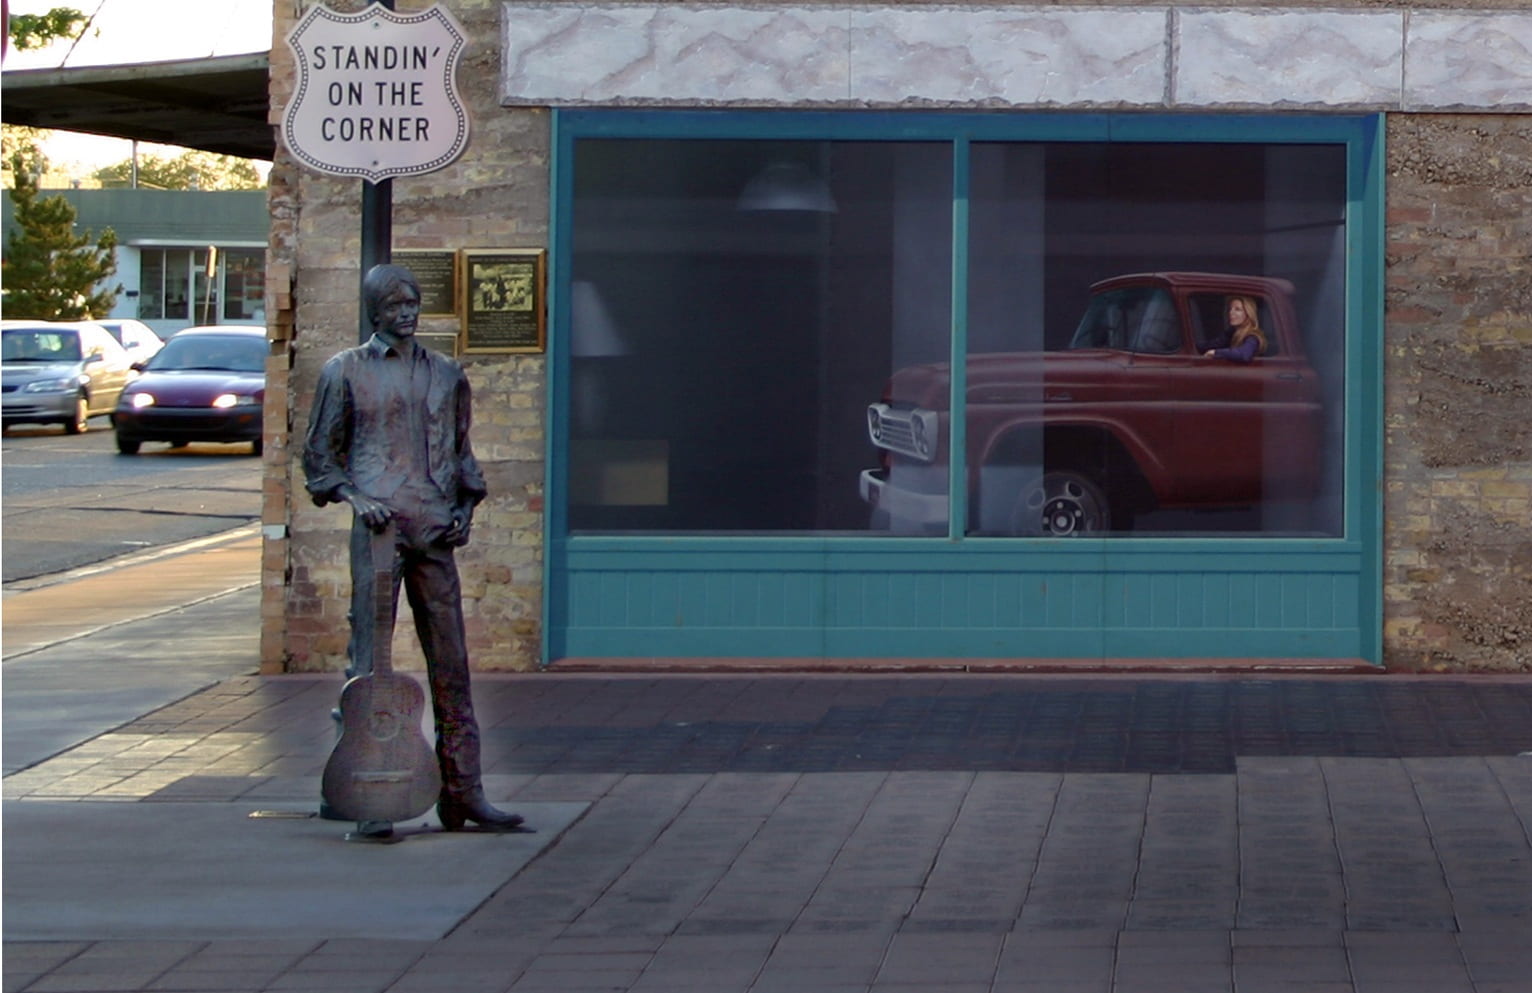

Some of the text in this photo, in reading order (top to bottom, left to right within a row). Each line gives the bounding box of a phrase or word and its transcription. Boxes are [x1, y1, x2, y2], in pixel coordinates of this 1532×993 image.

[313, 45, 441, 70] STANDIN'
[328, 81, 424, 106] ON THE
[321, 117, 430, 142] CORNER
